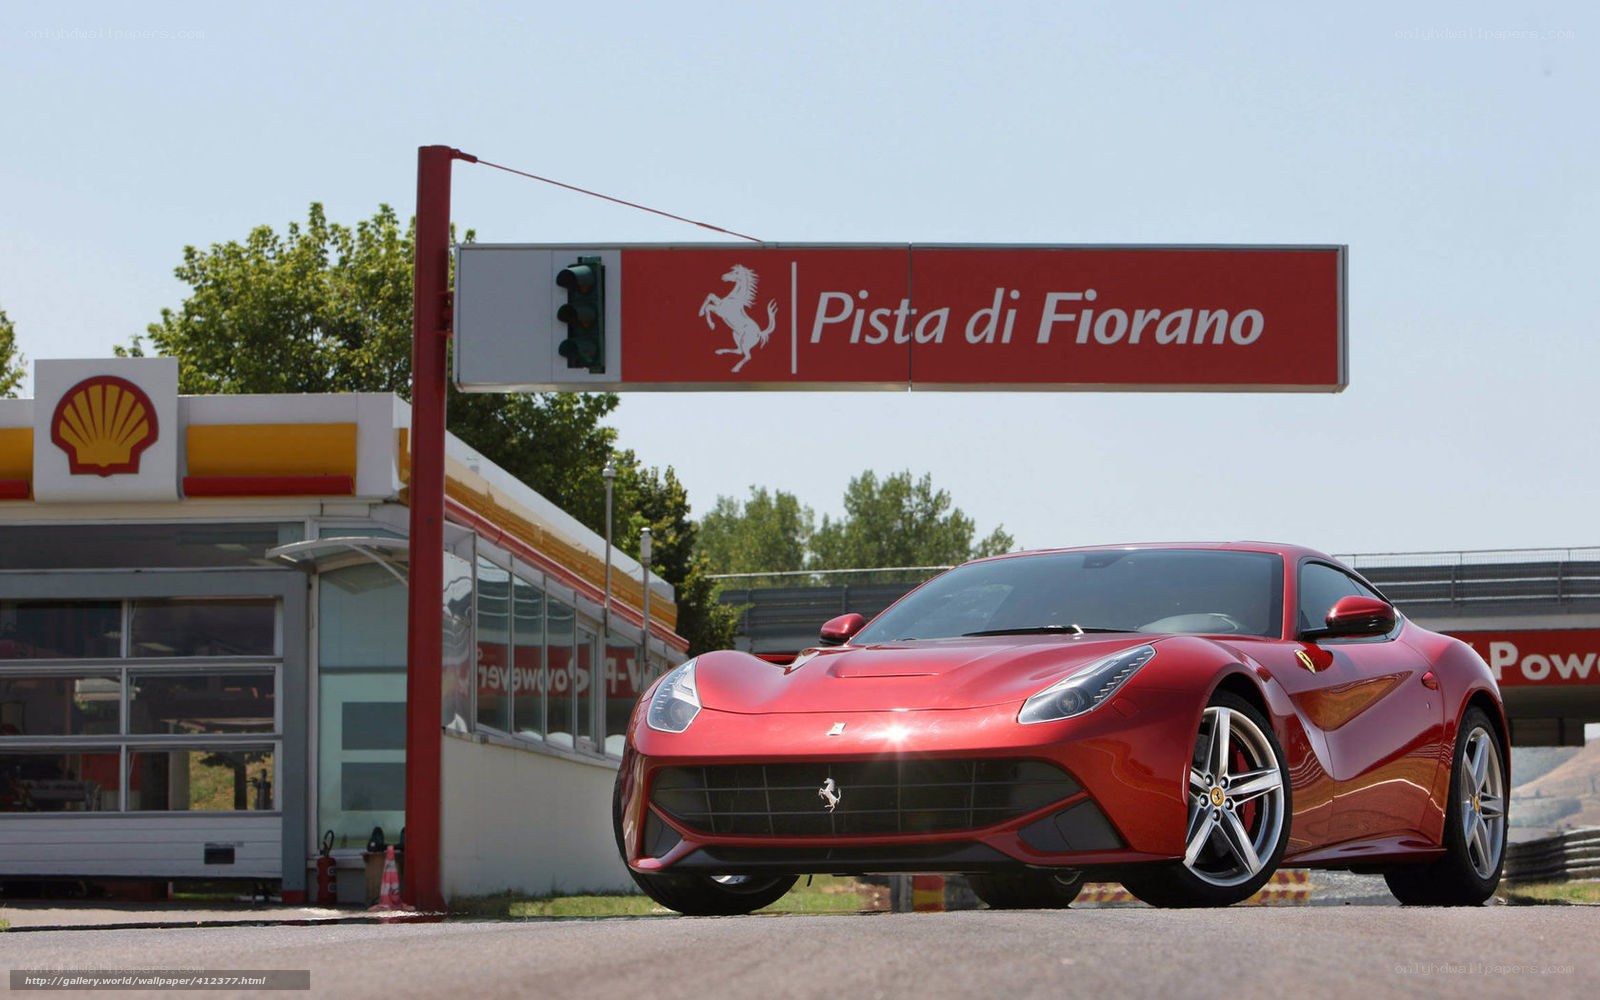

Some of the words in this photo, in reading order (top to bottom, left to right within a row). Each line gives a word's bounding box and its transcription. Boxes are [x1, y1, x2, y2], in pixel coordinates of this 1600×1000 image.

[810, 289, 950, 345] Pista
[964, 287, 1021, 345] di
[1036, 288, 1265, 346] Fiorano
[1488, 640, 1600, 681] Pow
